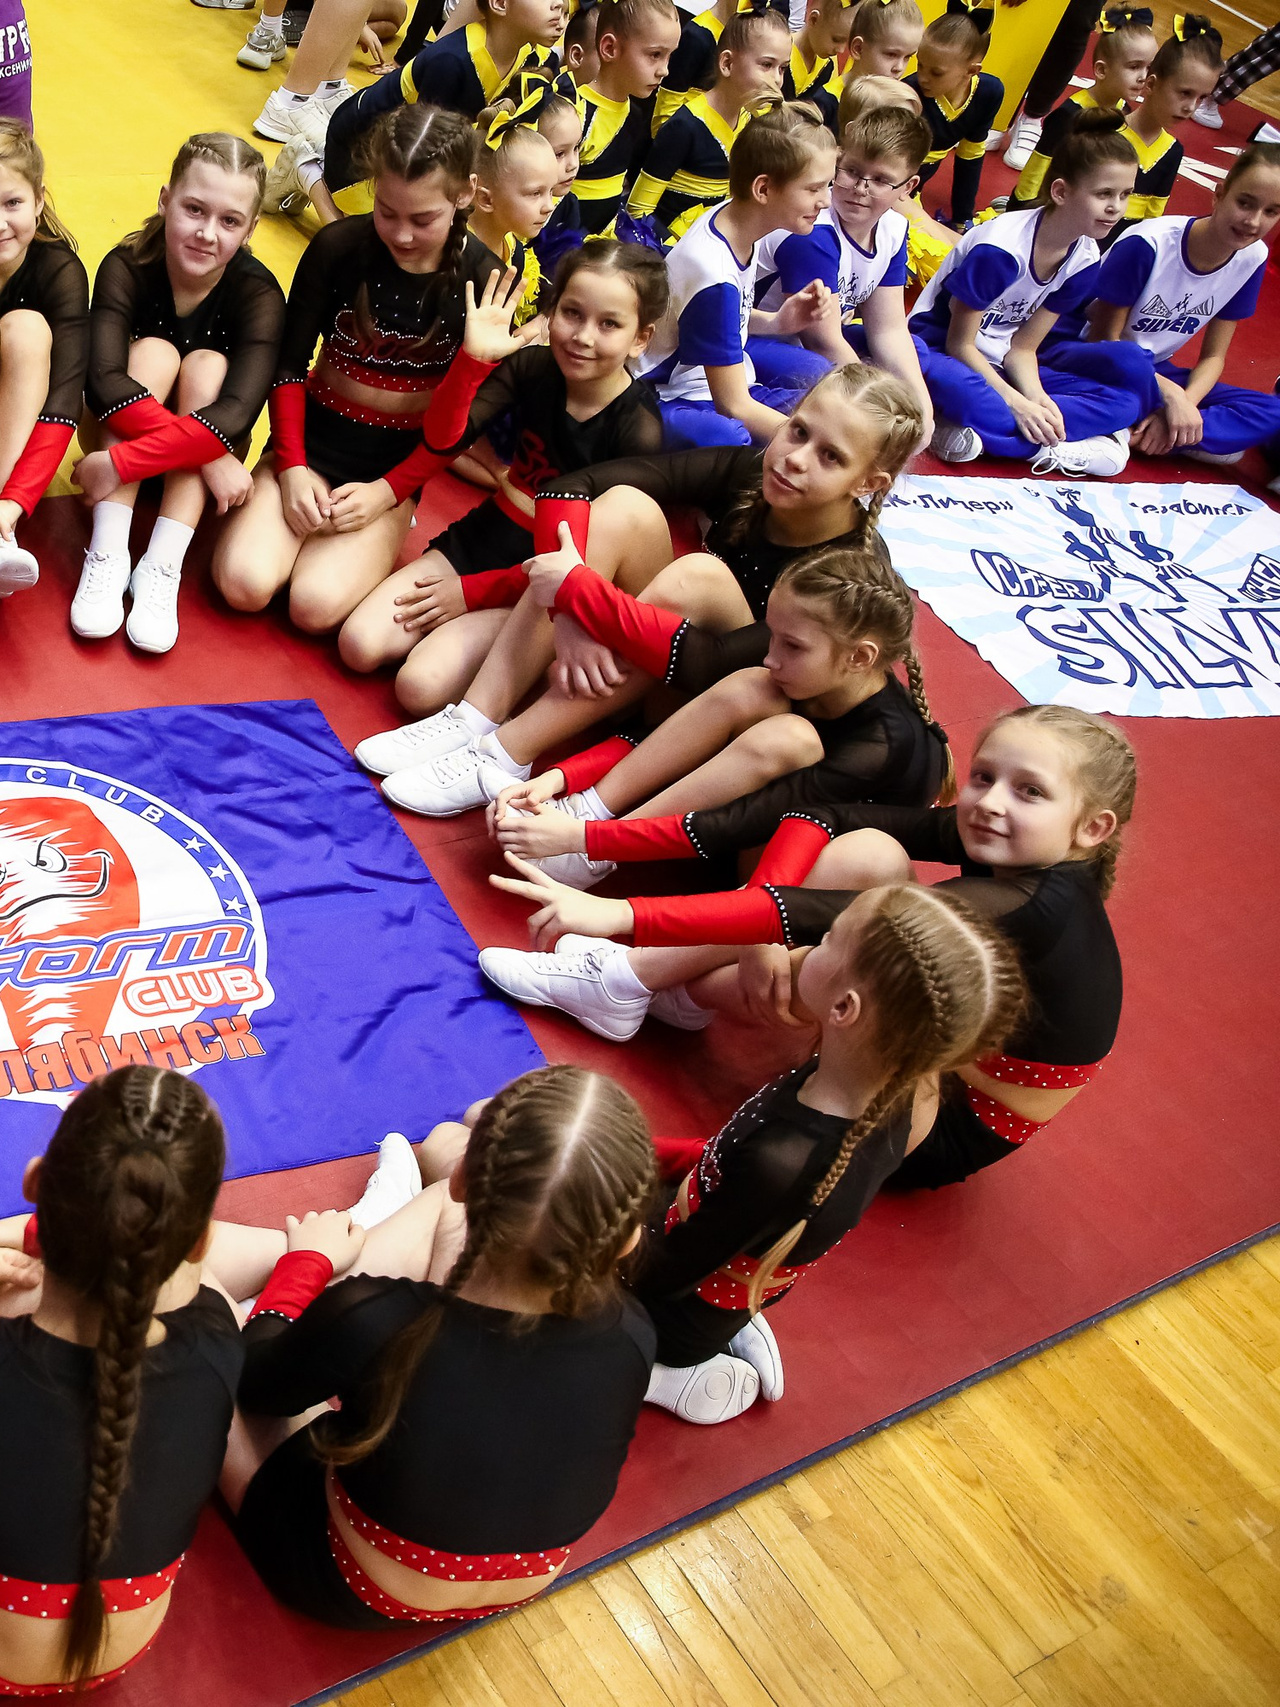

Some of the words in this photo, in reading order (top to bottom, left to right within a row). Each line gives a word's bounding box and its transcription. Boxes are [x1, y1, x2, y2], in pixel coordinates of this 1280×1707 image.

[1131, 316, 1200, 334] SILVER
[25, 766, 166, 825] CLUB
[123, 966, 264, 1017] CLUB
